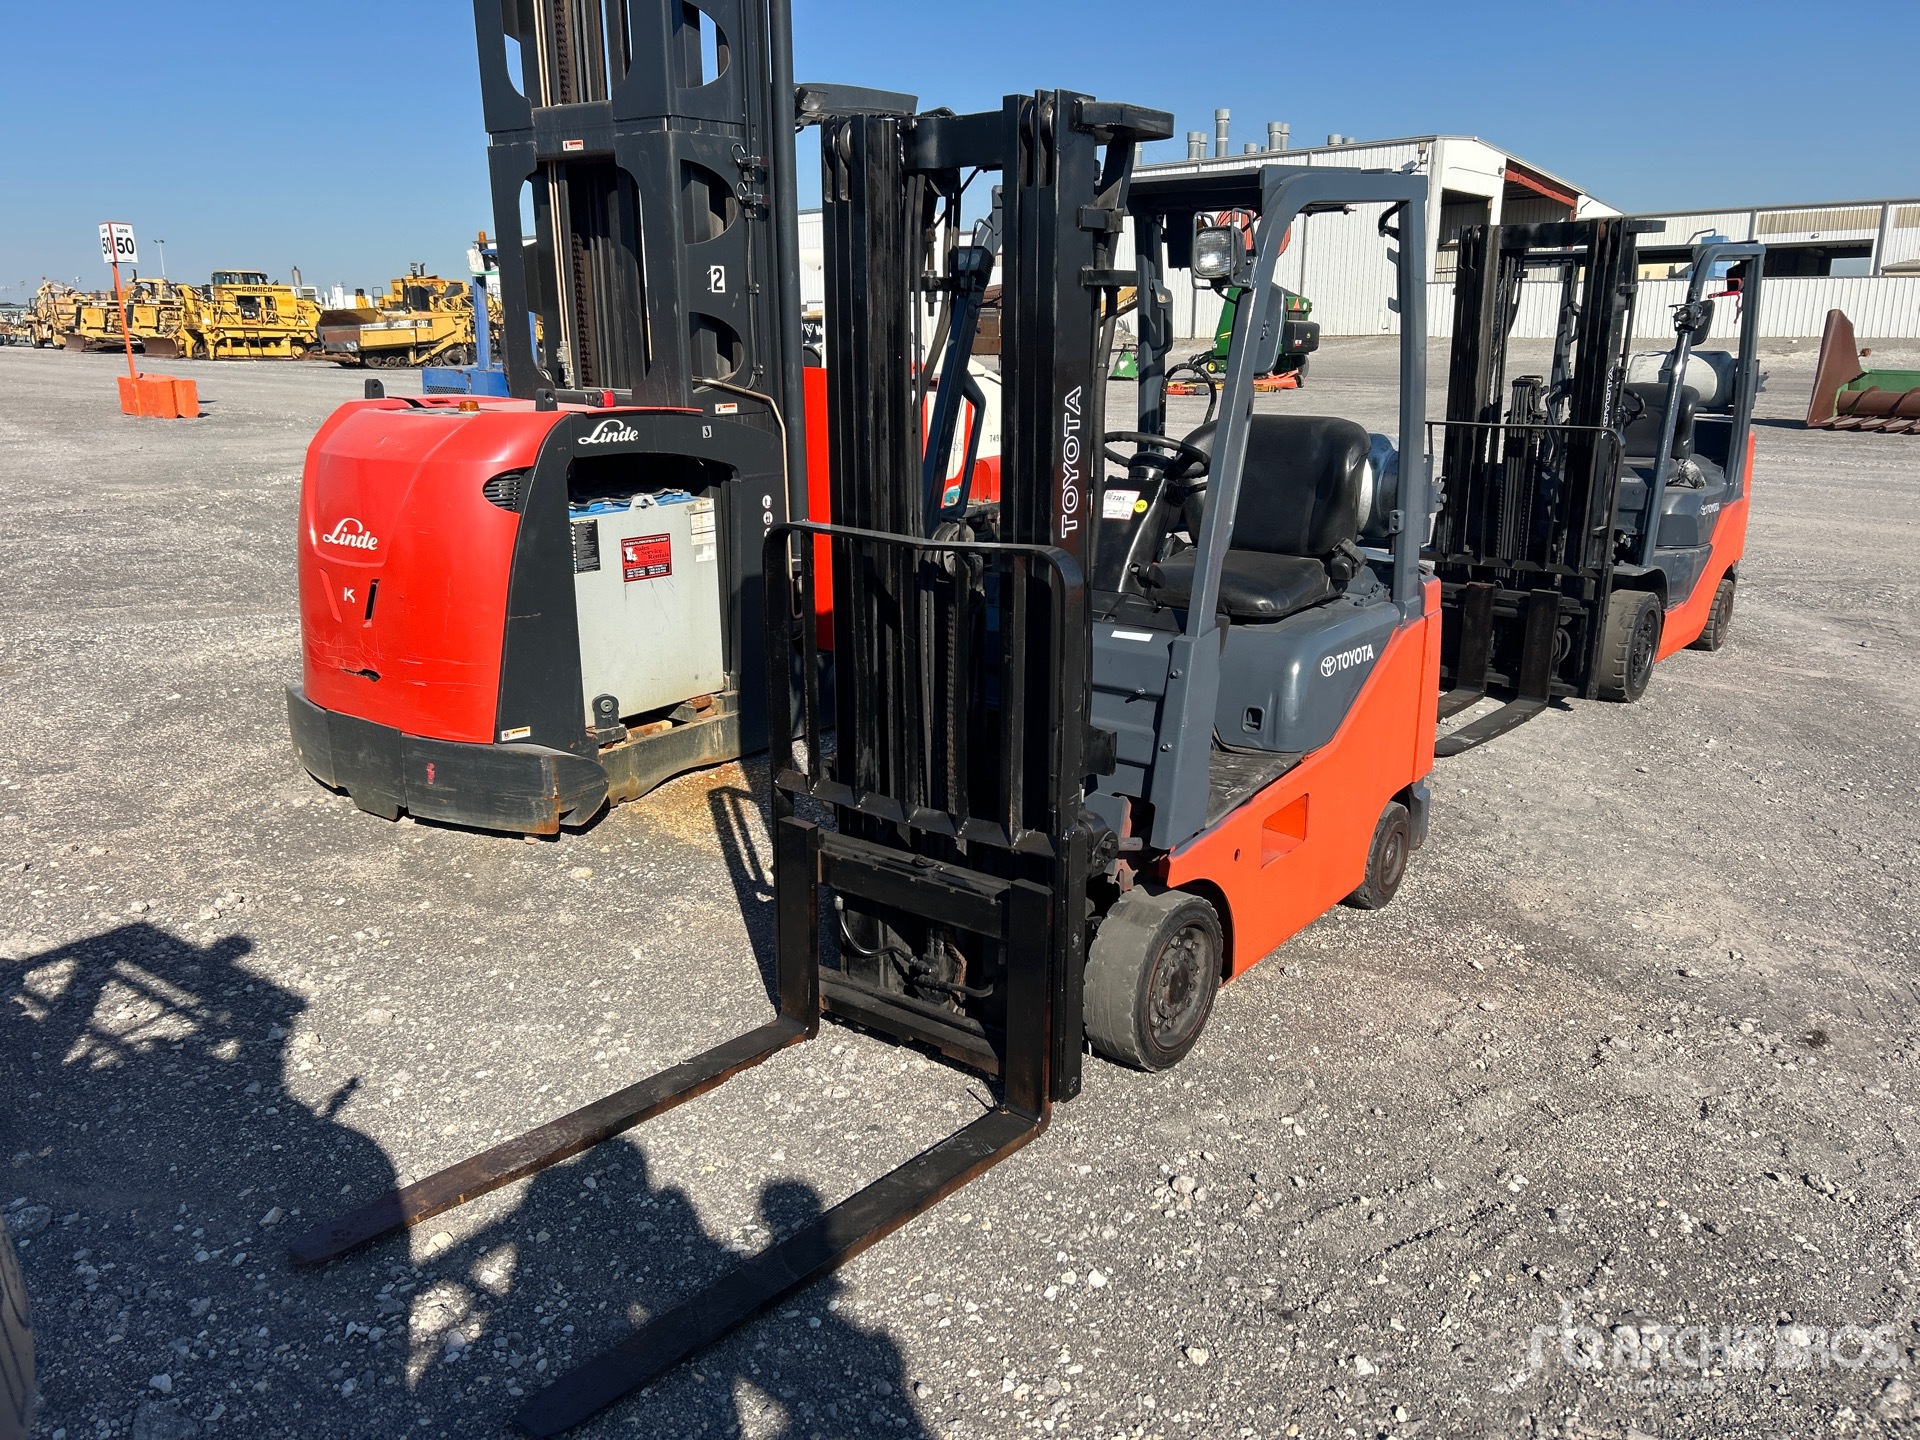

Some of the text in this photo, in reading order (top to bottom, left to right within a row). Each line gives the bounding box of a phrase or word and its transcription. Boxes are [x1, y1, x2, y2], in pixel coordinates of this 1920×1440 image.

[116, 237, 135, 255] 50
[713, 267, 723, 291] 2
[417, 320, 429, 328] CAT
[1601, 366, 1614, 439] TOYOTA
[578, 419, 638, 445] Linde
[1061, 385, 1082, 538] TOYOTA
[322, 517, 379, 551] Linde
[1336, 643, 1374, 671] TOYOTA
